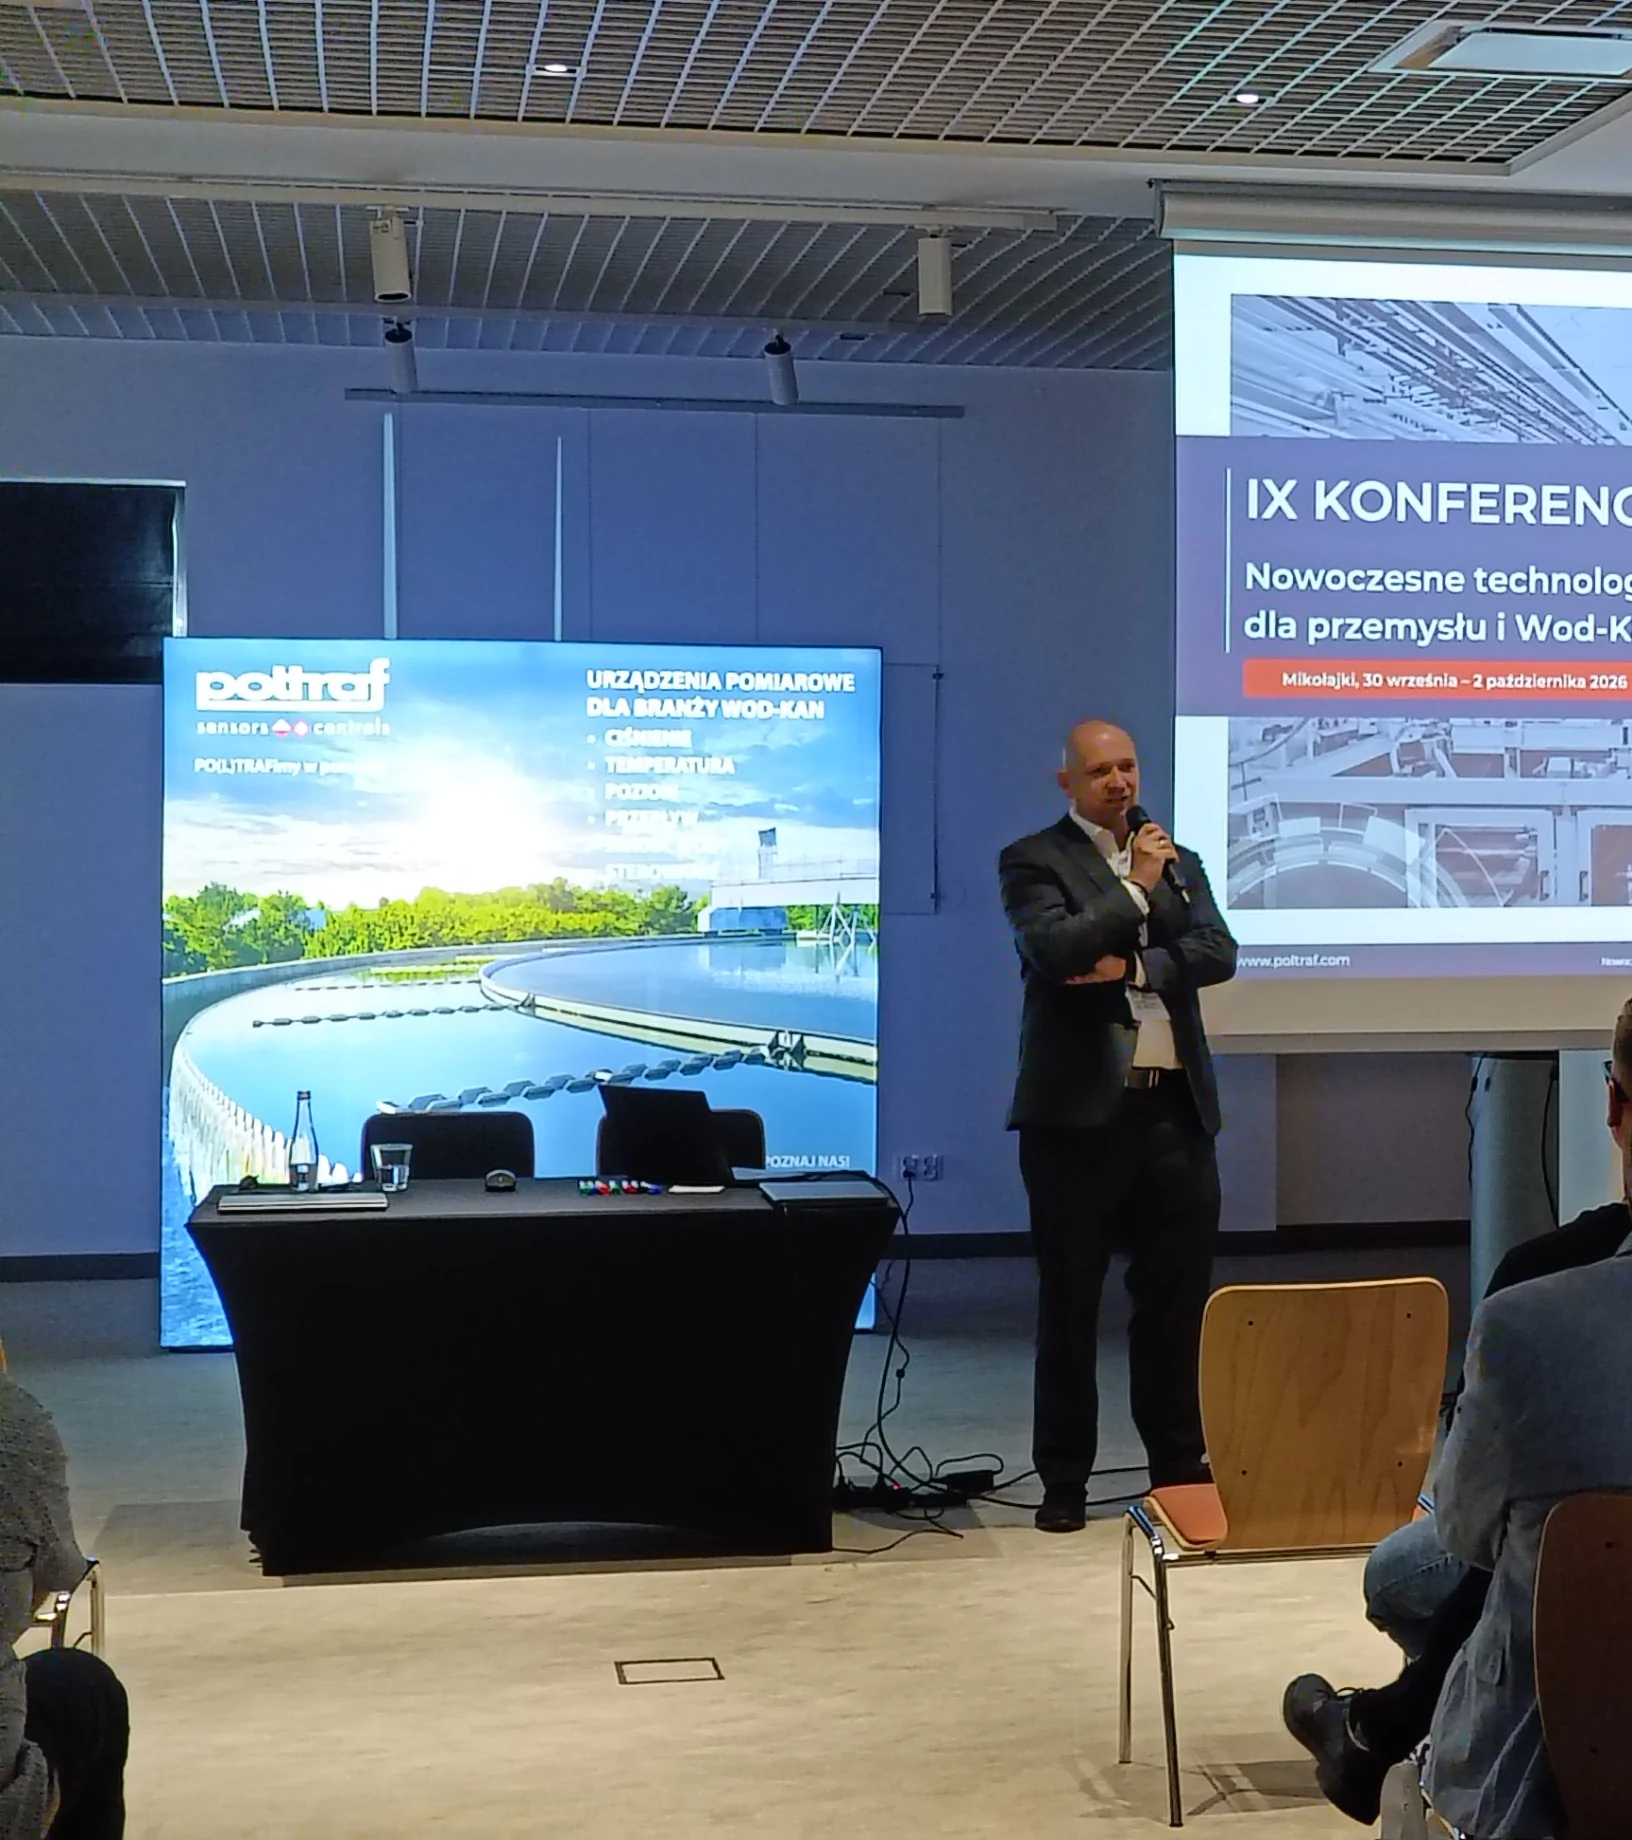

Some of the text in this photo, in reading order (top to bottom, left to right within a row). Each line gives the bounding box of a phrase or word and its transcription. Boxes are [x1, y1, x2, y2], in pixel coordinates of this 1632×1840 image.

[1247, 478, 1298, 520] IX
[1245, 562, 1465, 593] Nowoczesne
[1243, 610, 1297, 640] dla
[1307, 611, 1487, 648] przemysłu
[1497, 611, 1506, 641] i
[195, 657, 391, 713] poltraf
[586, 670, 856, 694] URZĄDZENIA POMIAROWE
[1282, 672, 1360, 690] Mikołajki,
[1362, 672, 1382, 688] 30
[1386, 672, 1458, 689] września
[1473, 674, 1483, 688] 2
[1485, 673, 1587, 691] października
[1589, 675, 1629, 690] 2026
[586, 695, 825, 719] DLA BRANŻY WOD-KAN
[196, 716, 390, 736] sensors controls
[604, 756, 736, 775] TEMPERATURA
